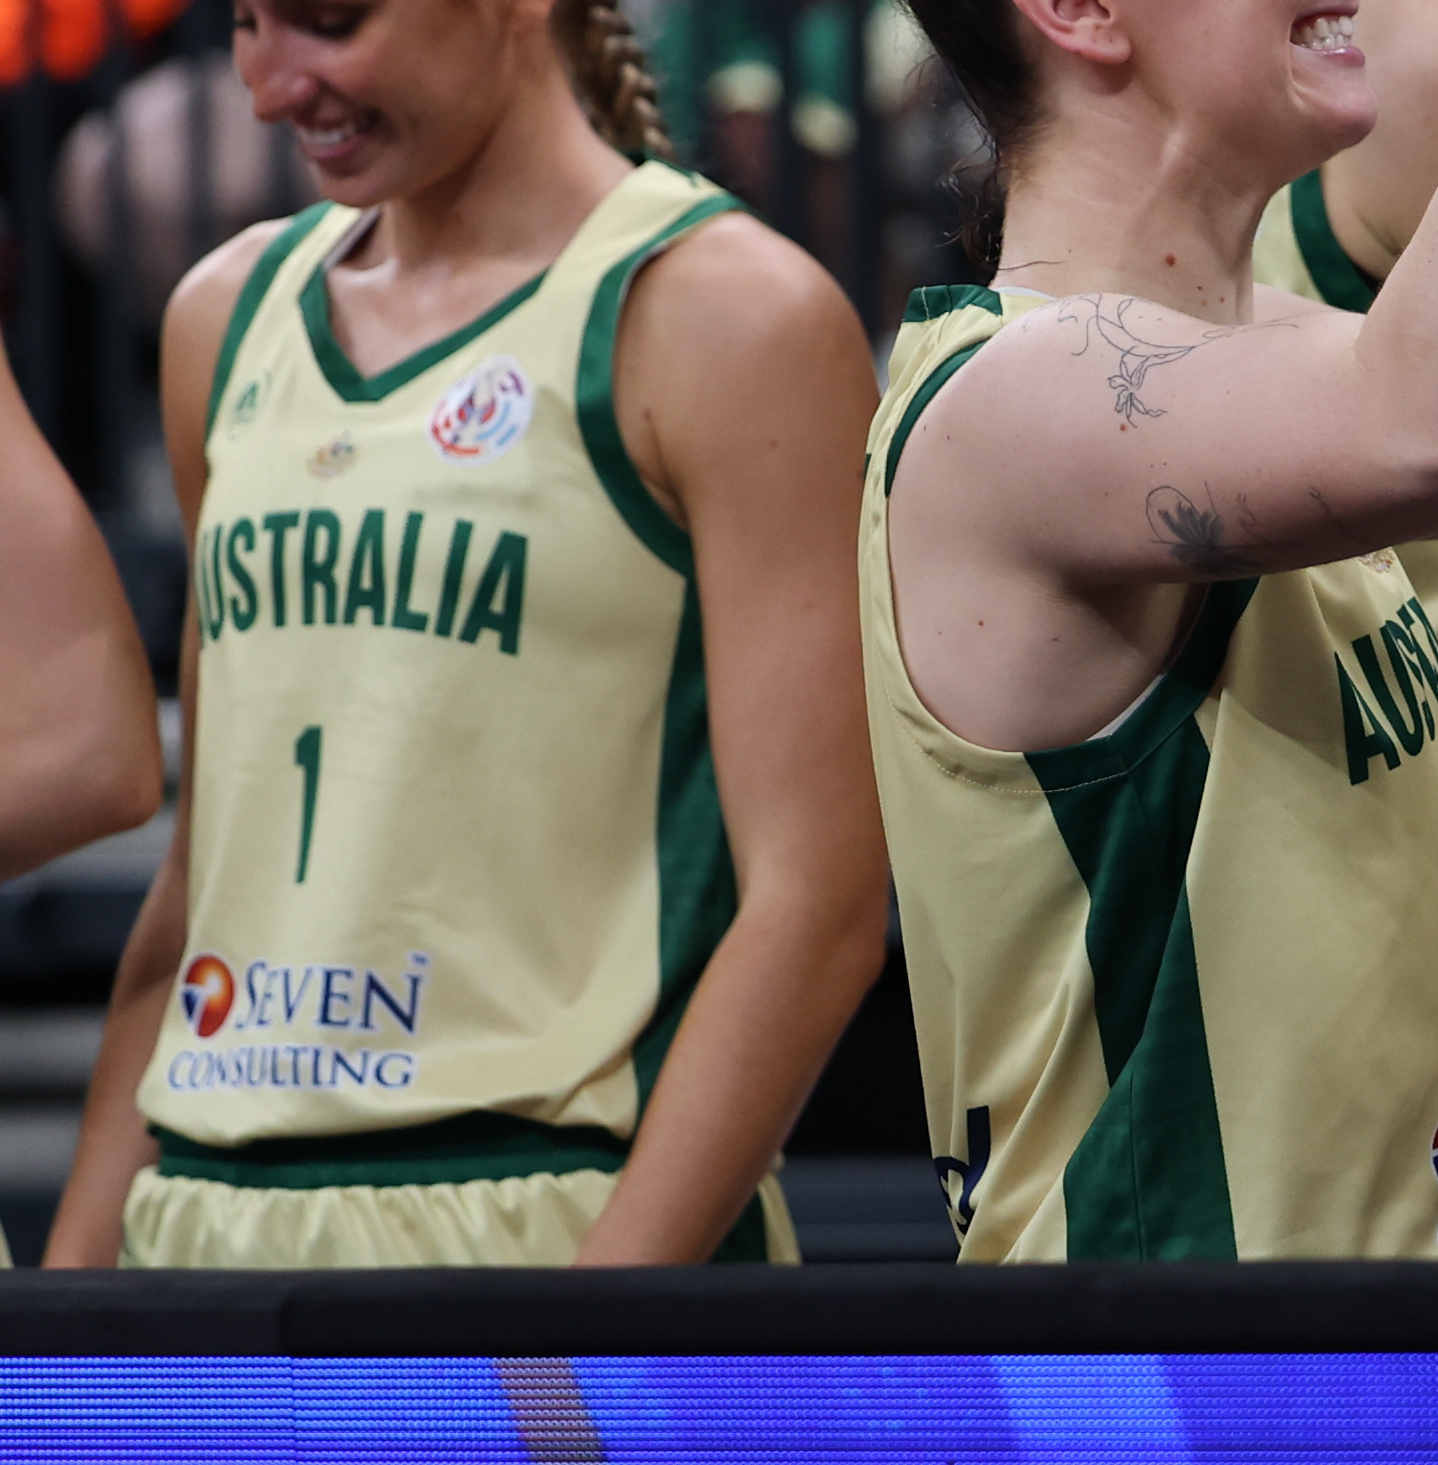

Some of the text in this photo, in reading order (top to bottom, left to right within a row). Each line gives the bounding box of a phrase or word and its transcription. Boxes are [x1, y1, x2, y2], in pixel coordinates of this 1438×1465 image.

[294, 724, 323, 885] 1
[235, 959, 421, 1033] SEVEN
[168, 1045, 414, 1089] CONSULTING
